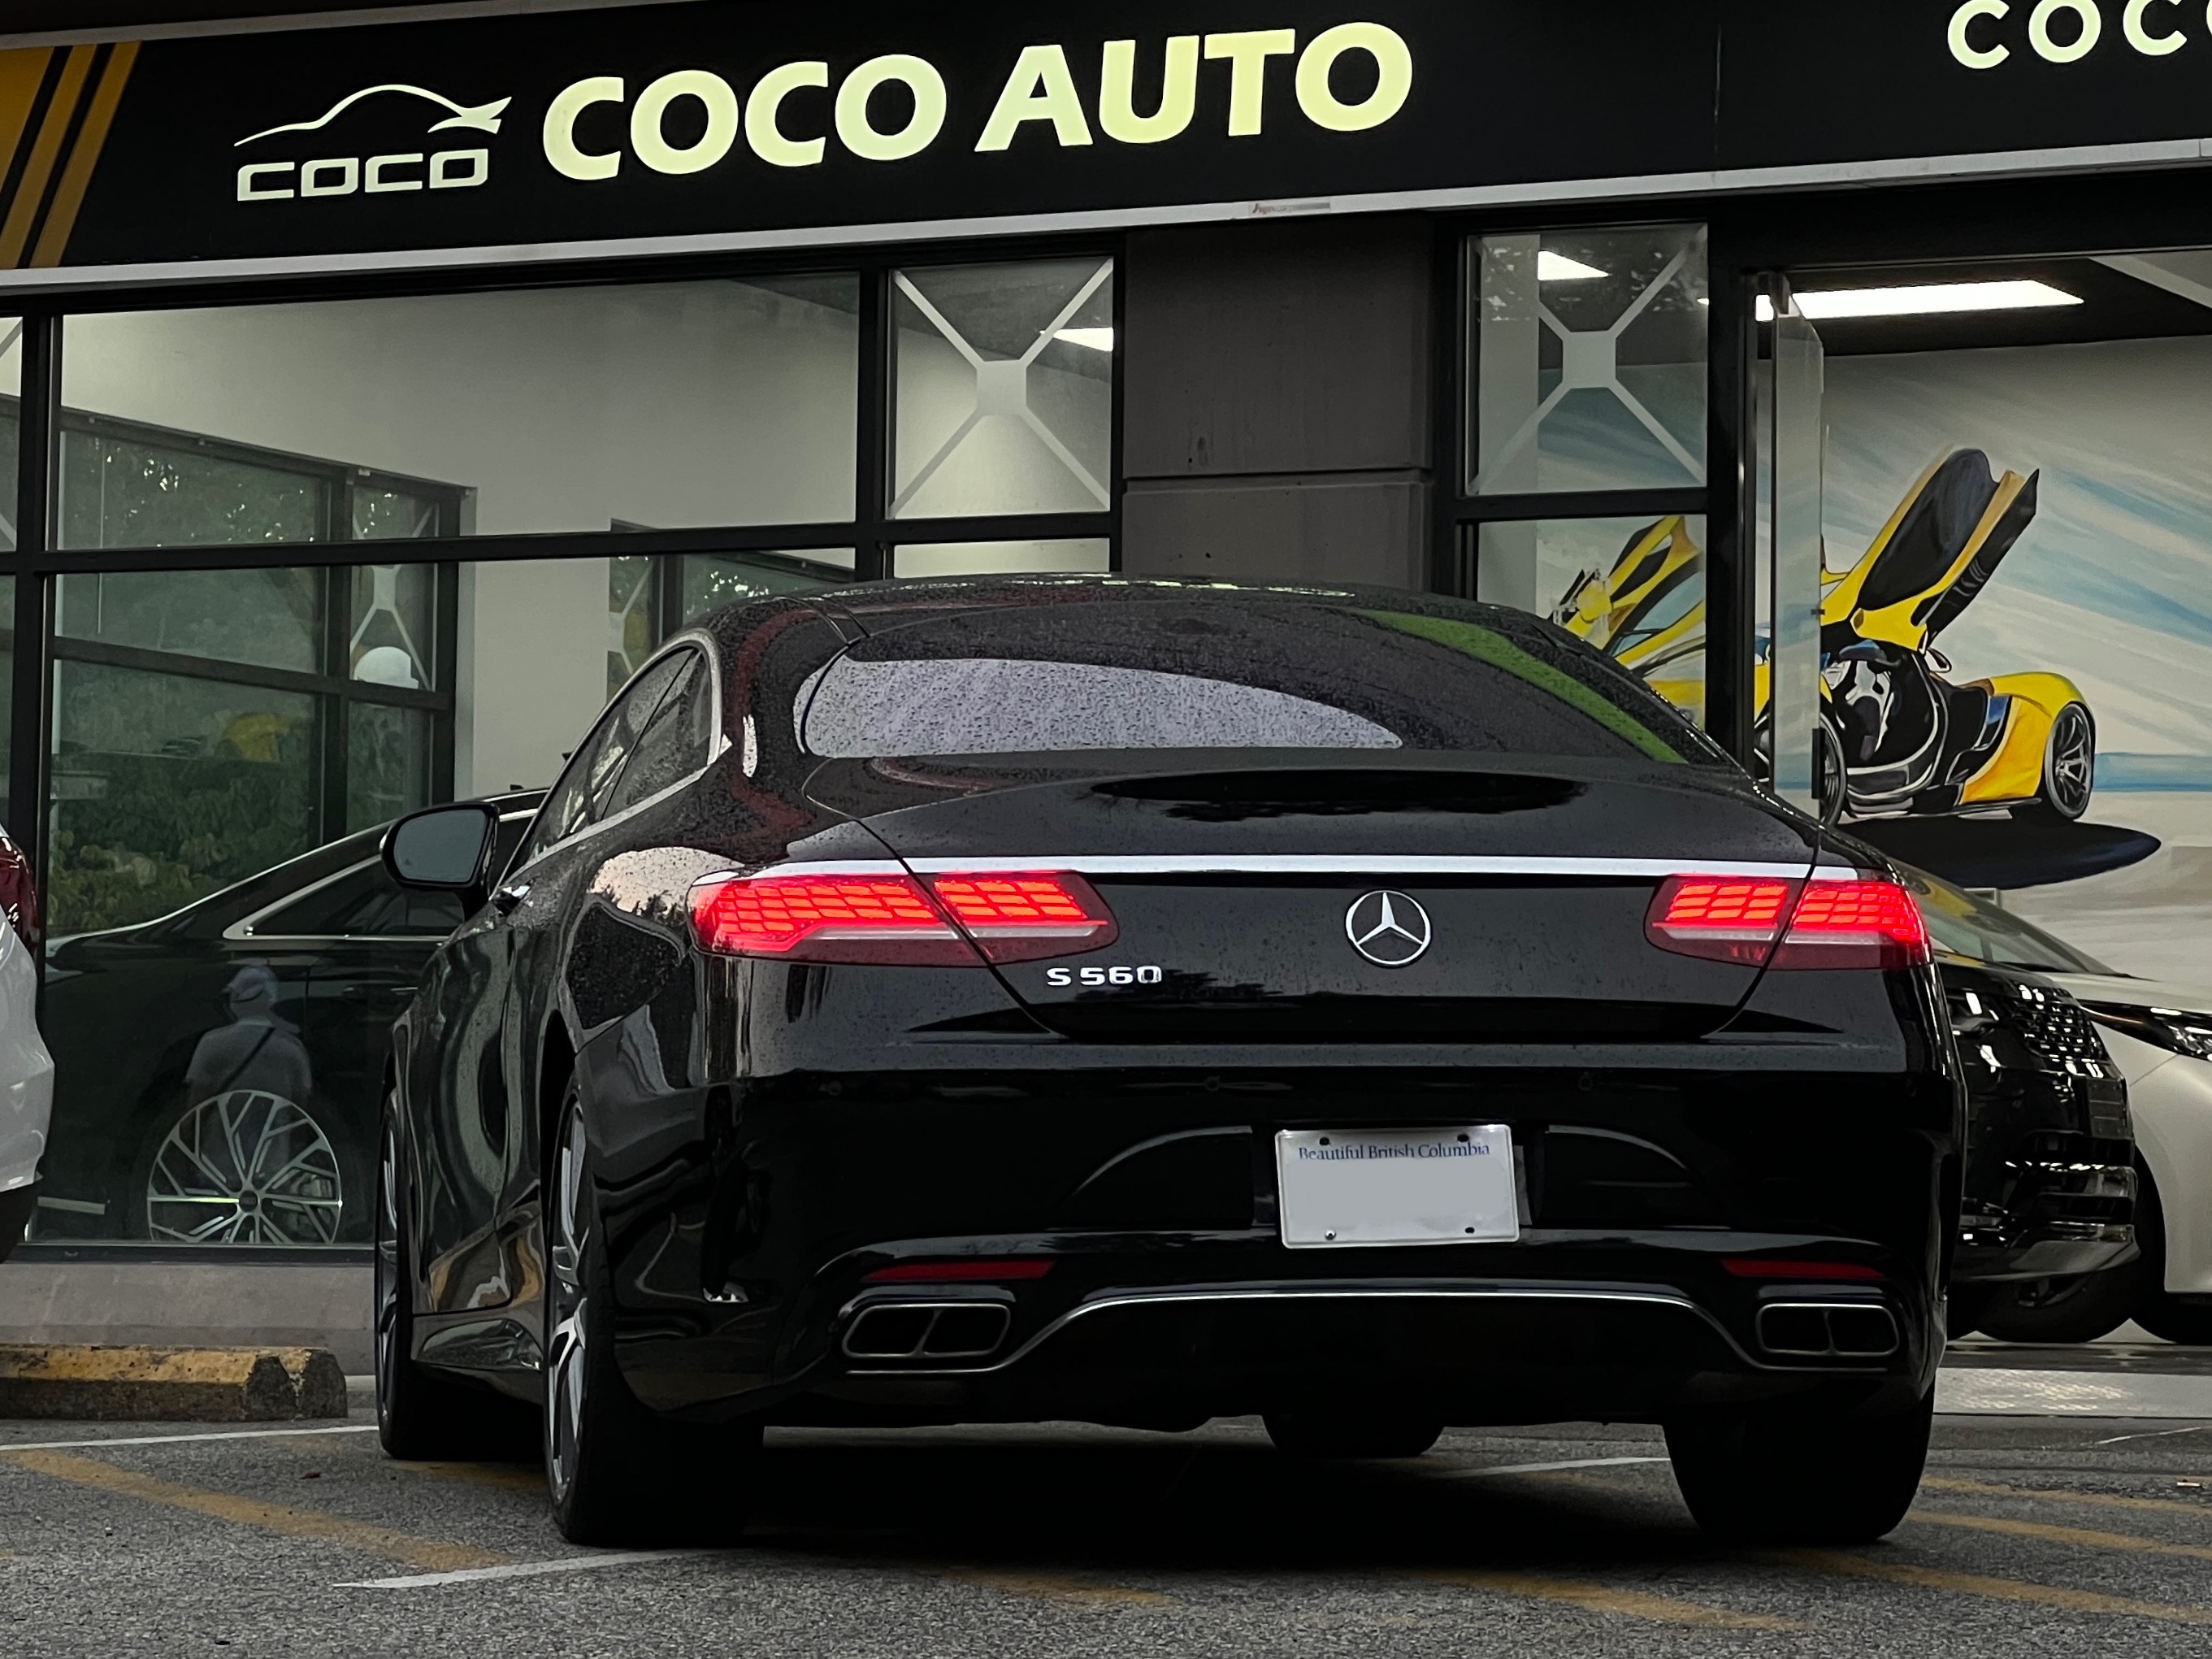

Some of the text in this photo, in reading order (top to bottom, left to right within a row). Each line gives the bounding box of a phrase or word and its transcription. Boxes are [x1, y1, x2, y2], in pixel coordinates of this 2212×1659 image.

[1947, 0, 2212, 70] COC
[543, 21, 1413, 180] COCO AUTO
[236, 148, 488, 202] COCO
[1046, 965, 1162, 986] S 560
[1299, 1140, 1490, 1160] Beautiful British Columbia
